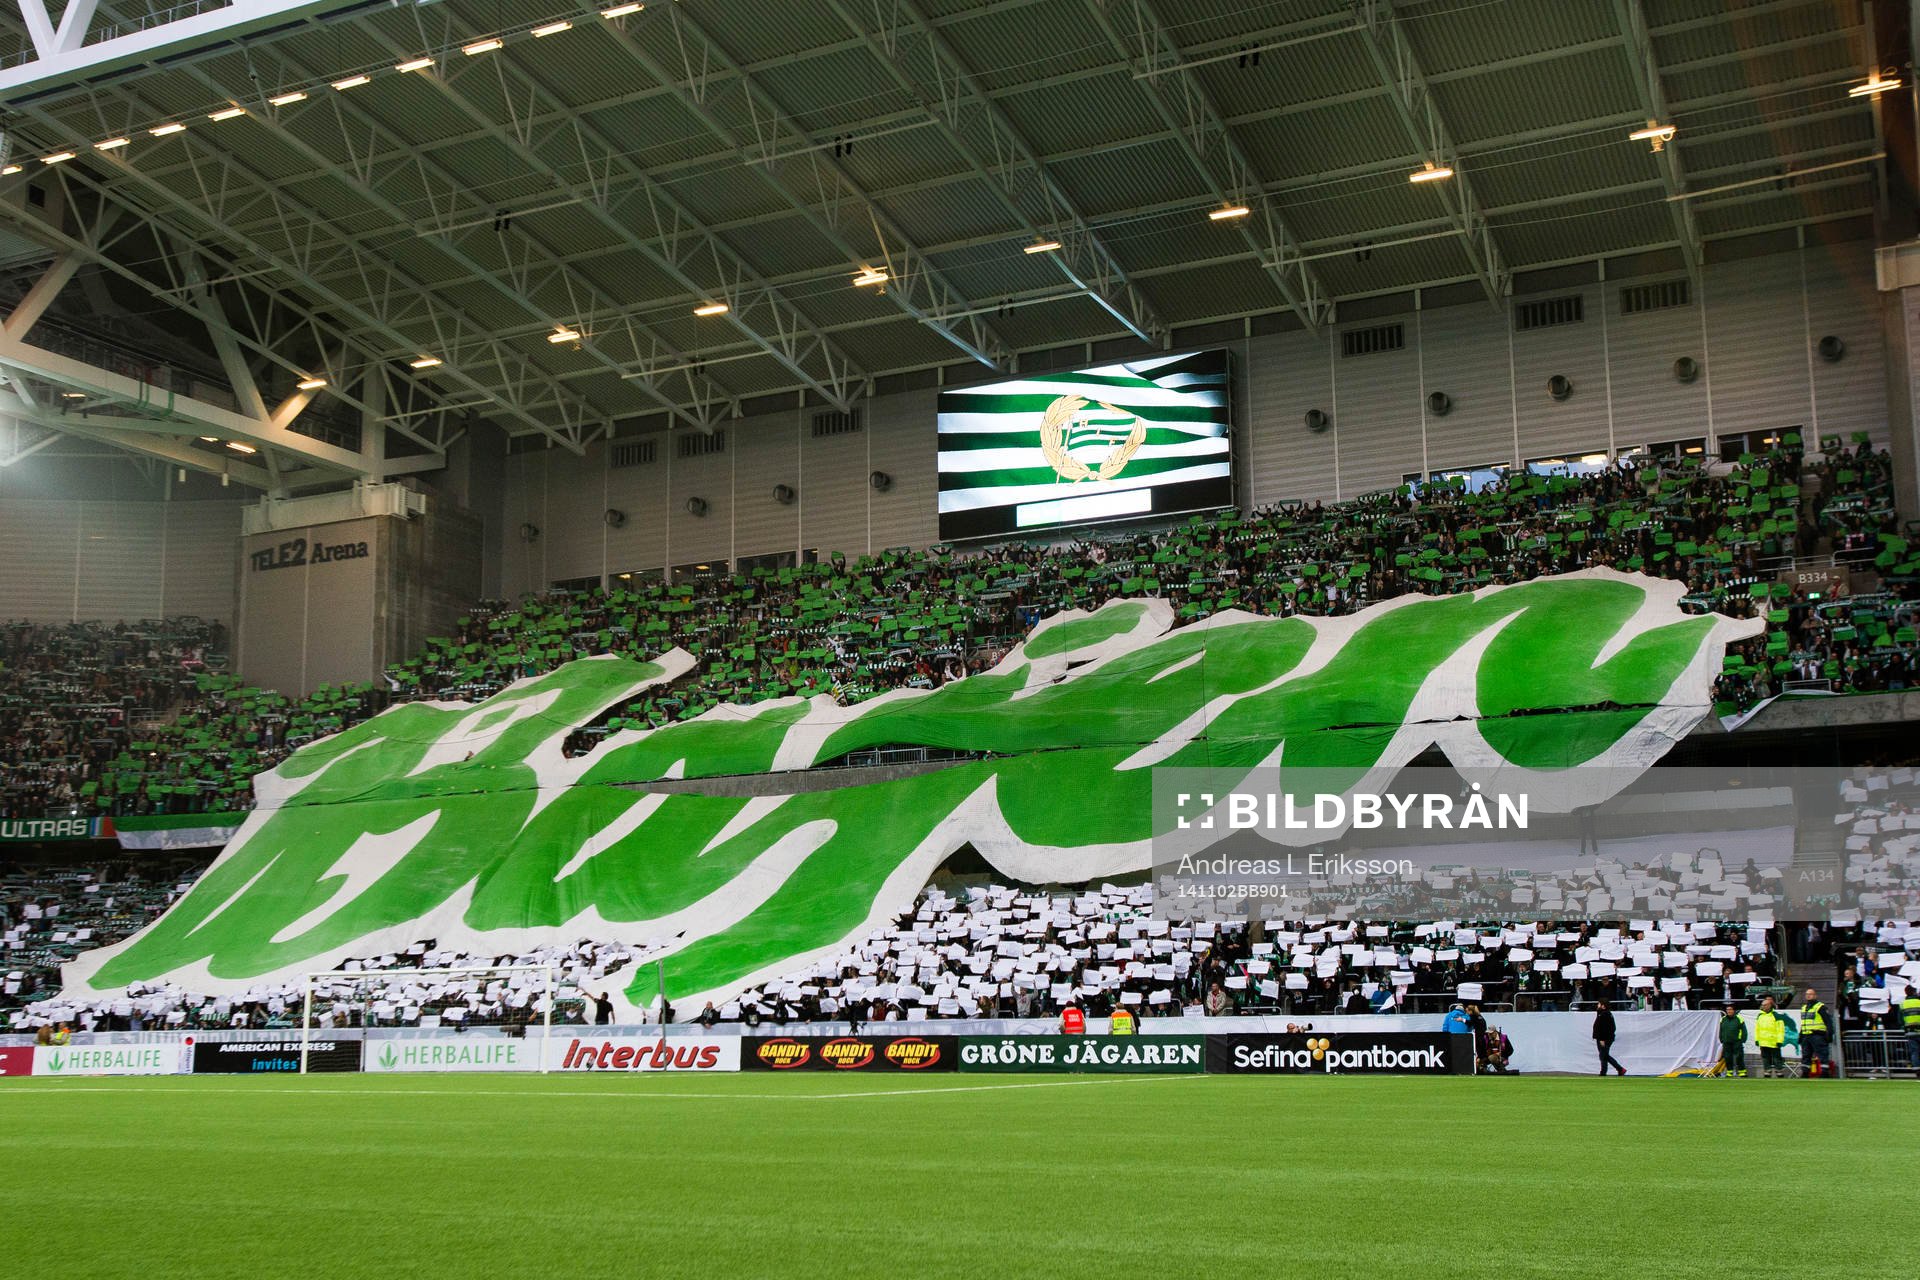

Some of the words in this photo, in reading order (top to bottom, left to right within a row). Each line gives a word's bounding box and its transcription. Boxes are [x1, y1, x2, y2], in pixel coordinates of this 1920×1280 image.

[250, 538, 307, 572] TELE2
[309, 541, 369, 565] Arena
[1799, 572, 1828, 584] B334
[1, 818, 88, 838] ULTRAS
[1799, 869, 1834, 882] A134
[219, 1042, 282, 1053] AMERICAN
[404, 1044, 517, 1065] HERBALIFE
[562, 1039, 720, 1069] Interbus
[759, 1044, 810, 1057] BANDIT
[822, 1044, 873, 1057] BANDIT
[887, 1044, 939, 1057] BANDIT
[961, 1039, 1055, 1065] GRÖNE
[1063, 1039, 1202, 1065] JÄGAREN
[69, 1049, 161, 1068] HERBALIFE
[252, 1057, 298, 1070] invites
[1233, 1045, 1312, 1069] Sefina
[1326, 1045, 1445, 1073] pantbank
